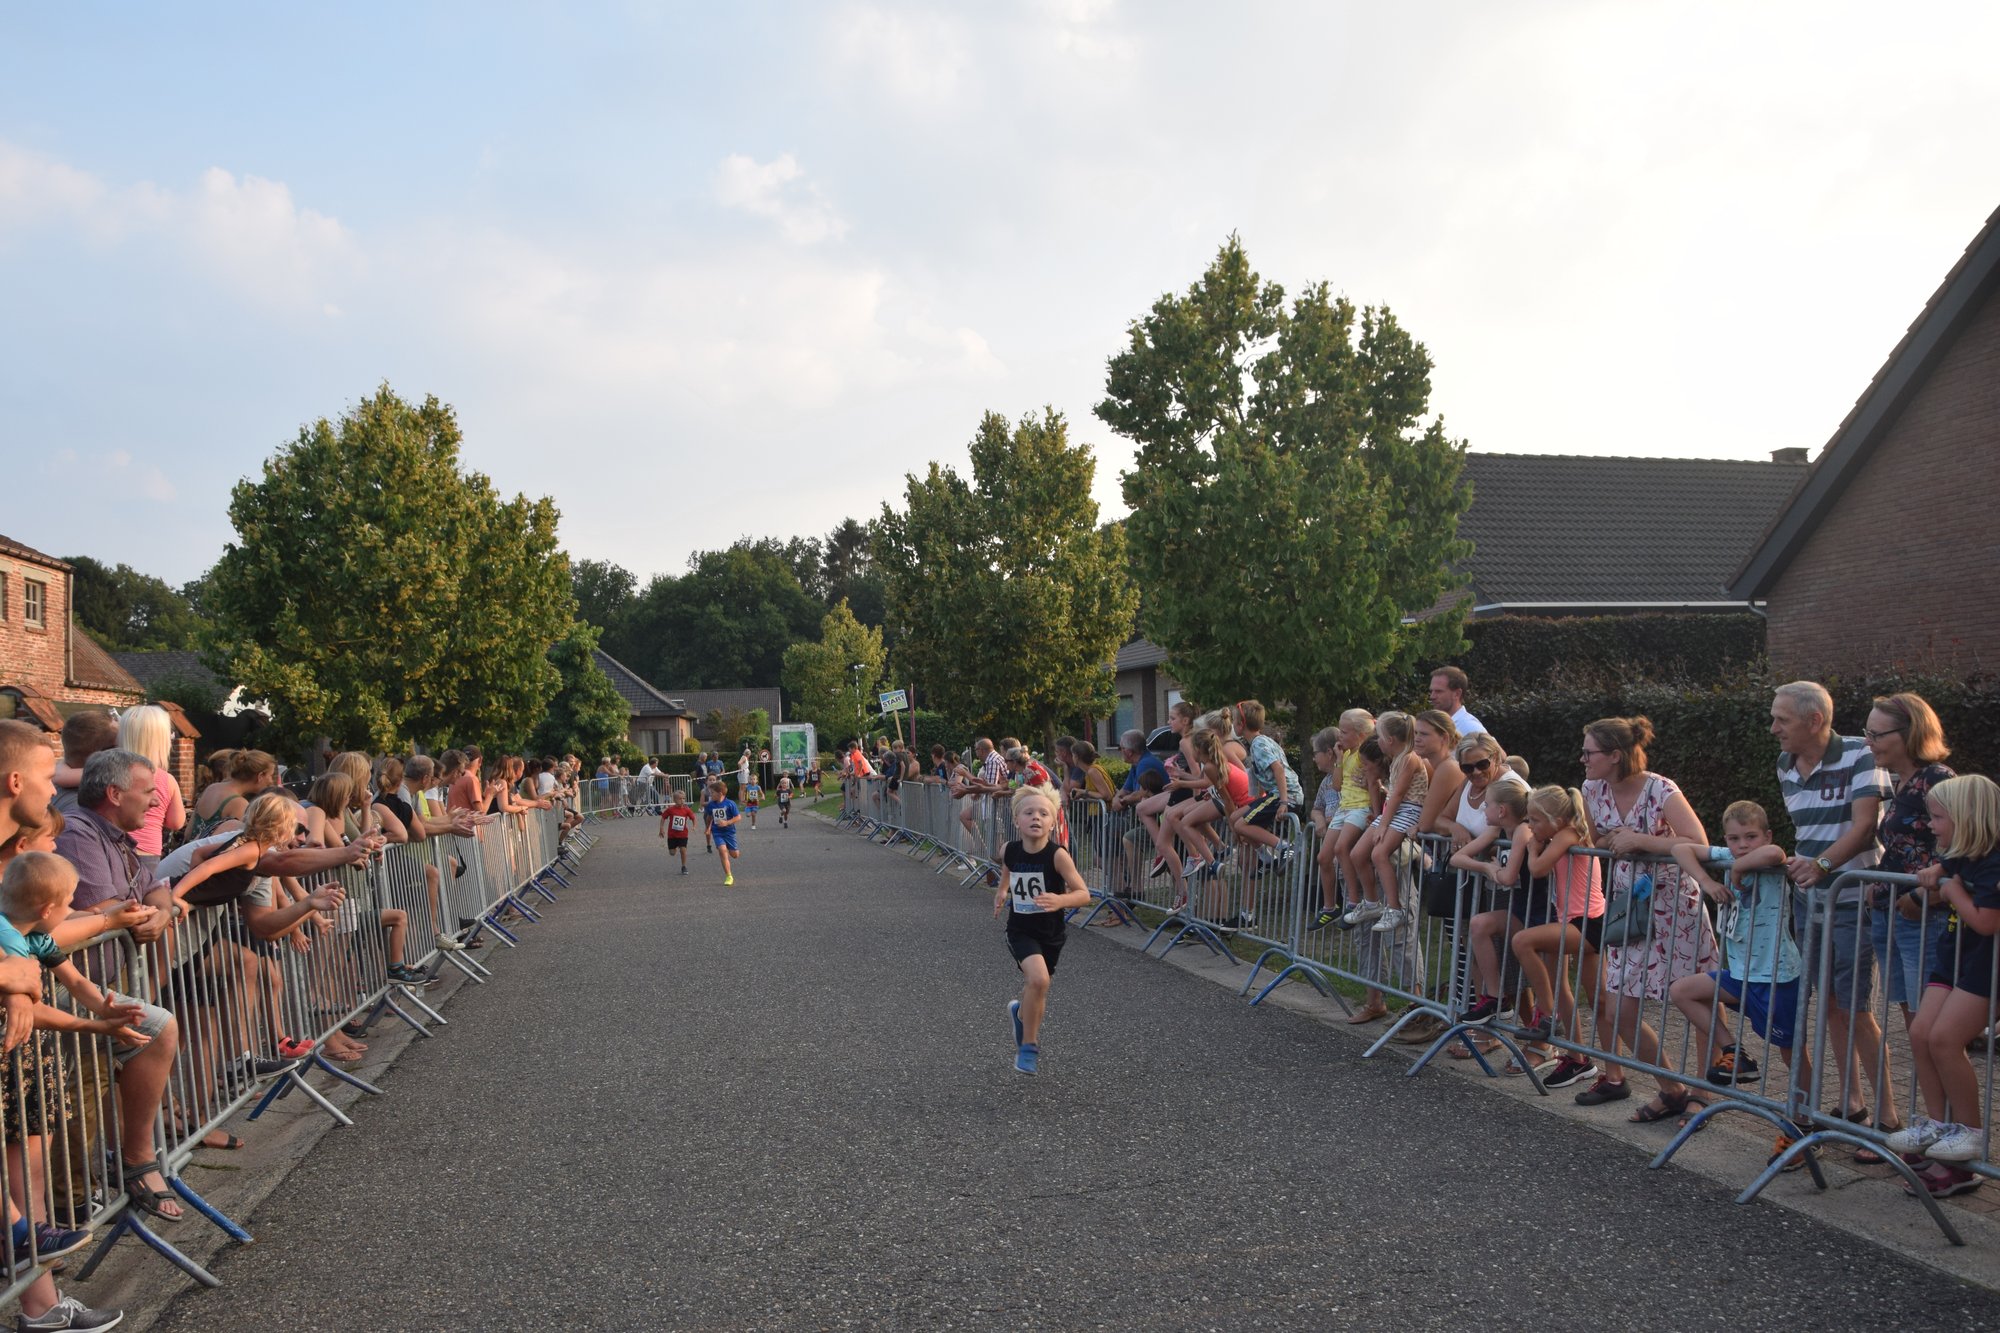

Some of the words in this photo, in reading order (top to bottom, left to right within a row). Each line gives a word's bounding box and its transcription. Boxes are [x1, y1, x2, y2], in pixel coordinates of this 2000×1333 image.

[882, 694, 905, 708] START
[715, 809, 724, 818] 49
[674, 817, 684, 826] 50
[1014, 877, 1042, 900] 46
